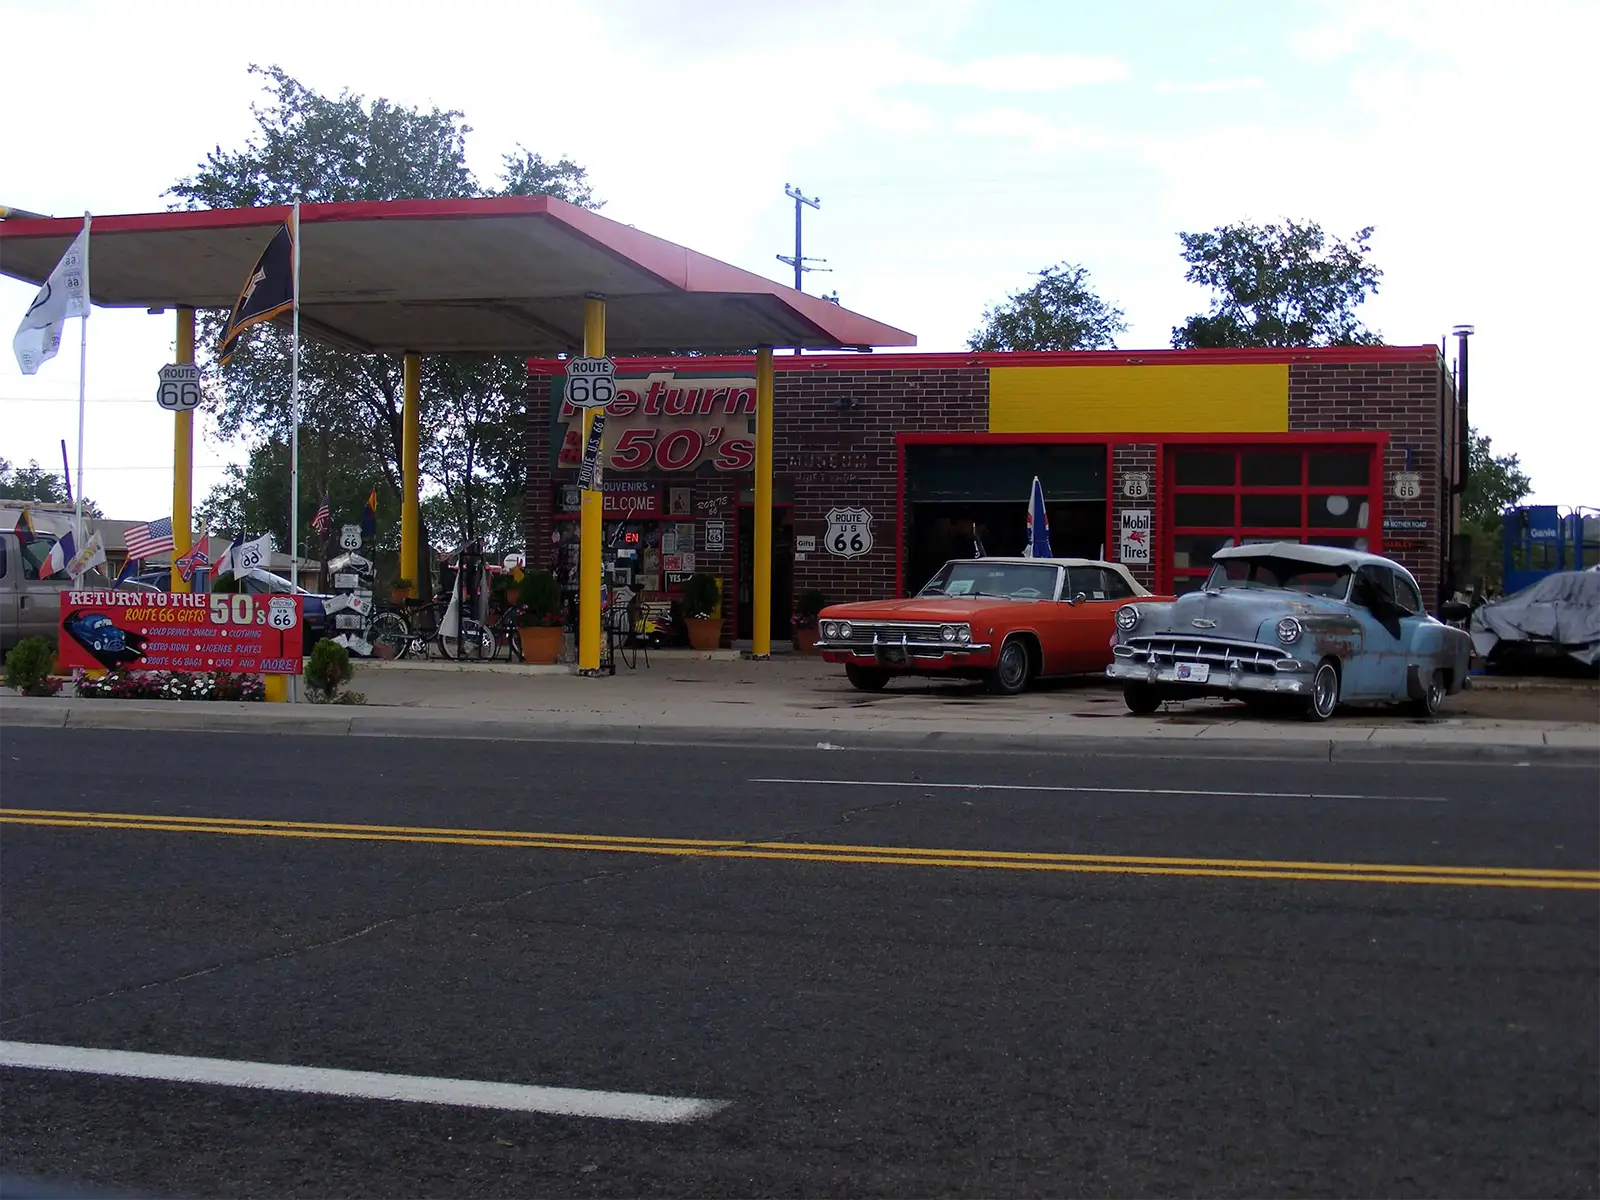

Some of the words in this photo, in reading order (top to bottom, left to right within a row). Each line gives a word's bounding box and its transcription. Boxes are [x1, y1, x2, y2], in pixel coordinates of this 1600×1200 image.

[573, 362, 609, 373] ROUTE
[164, 368, 196, 379] ROUTE
[162, 383, 198, 406] 66
[570, 377, 612, 402] 66
[562, 381, 756, 417] eturn
[580, 455, 595, 483] ROUTE
[593, 421, 604, 433] 66
[609, 427, 755, 470] 50's
[603, 482, 648, 491] OUVENIRS
[1129, 485, 1142, 495] 66
[1400, 486, 1414, 496] 66
[603, 496, 655, 511] ELCOME
[835, 514, 862, 522] ROUTE
[1122, 515, 1149, 529] Mobil
[344, 538, 357, 547] 66
[624, 532, 639, 543] EN
[834, 533, 863, 552] 66
[1122, 544, 1147, 558] Tires
[69, 591, 143, 606] RETURN
[145, 592, 168, 606] TO
[170, 593, 206, 607] THE
[210, 594, 266, 625] 50's
[125, 608, 157, 622] ROUTE
[158, 608, 175, 622] 66
[177, 608, 206, 623] GIFTS
[274, 614, 291, 626] 66
[149, 627, 167, 636] COLD
[167, 628, 190, 636] DRINKS
[192, 628, 217, 637] SNACKS
[228, 629, 262, 638] CLOTHING
[148, 642, 169, 651] RETRO
[169, 643, 190, 652] SIGNS
[201, 644, 232, 653] LICENSE
[235, 644, 262, 654] PLATES
[147, 657, 169, 665] ROUTE
[172, 657, 183, 665] 66
[183, 658, 203, 666] BAGS
[239, 659, 255, 667] AND
[259, 659, 297, 671] MORE!
